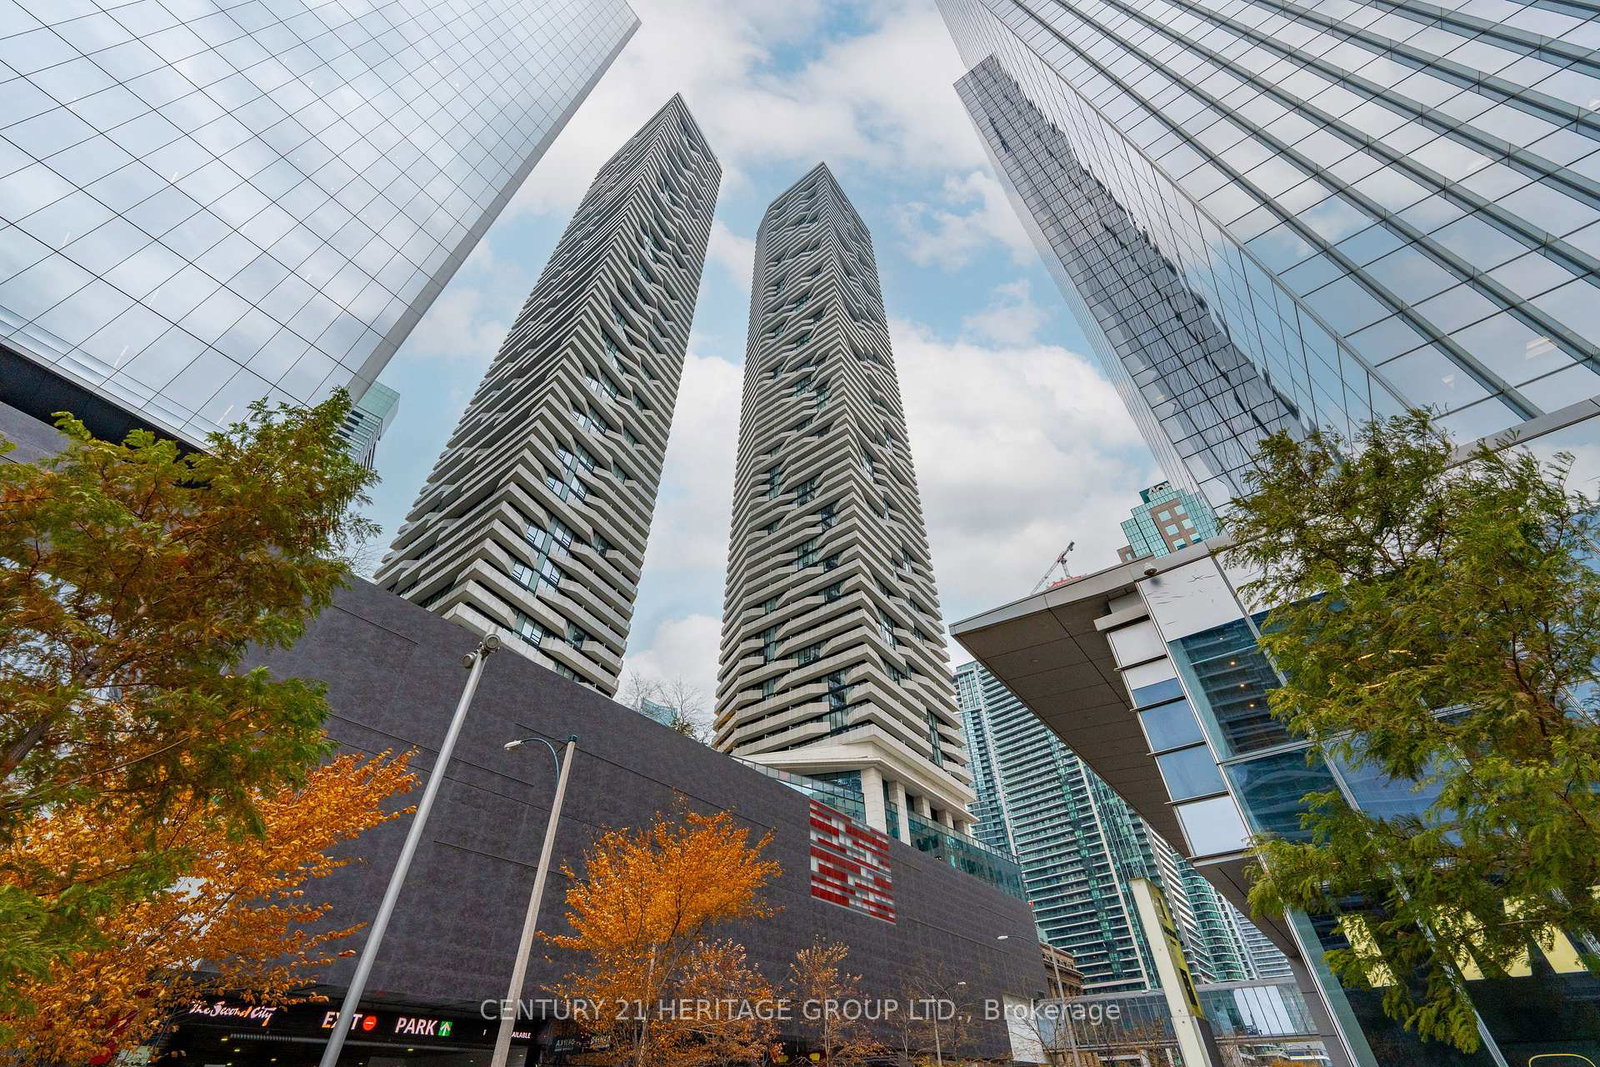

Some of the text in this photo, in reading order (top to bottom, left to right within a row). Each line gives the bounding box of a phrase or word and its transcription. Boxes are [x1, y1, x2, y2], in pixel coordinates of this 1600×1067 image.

[189, 1000, 277, 1027] The Second City
[395, 1017, 438, 1036] PARK
